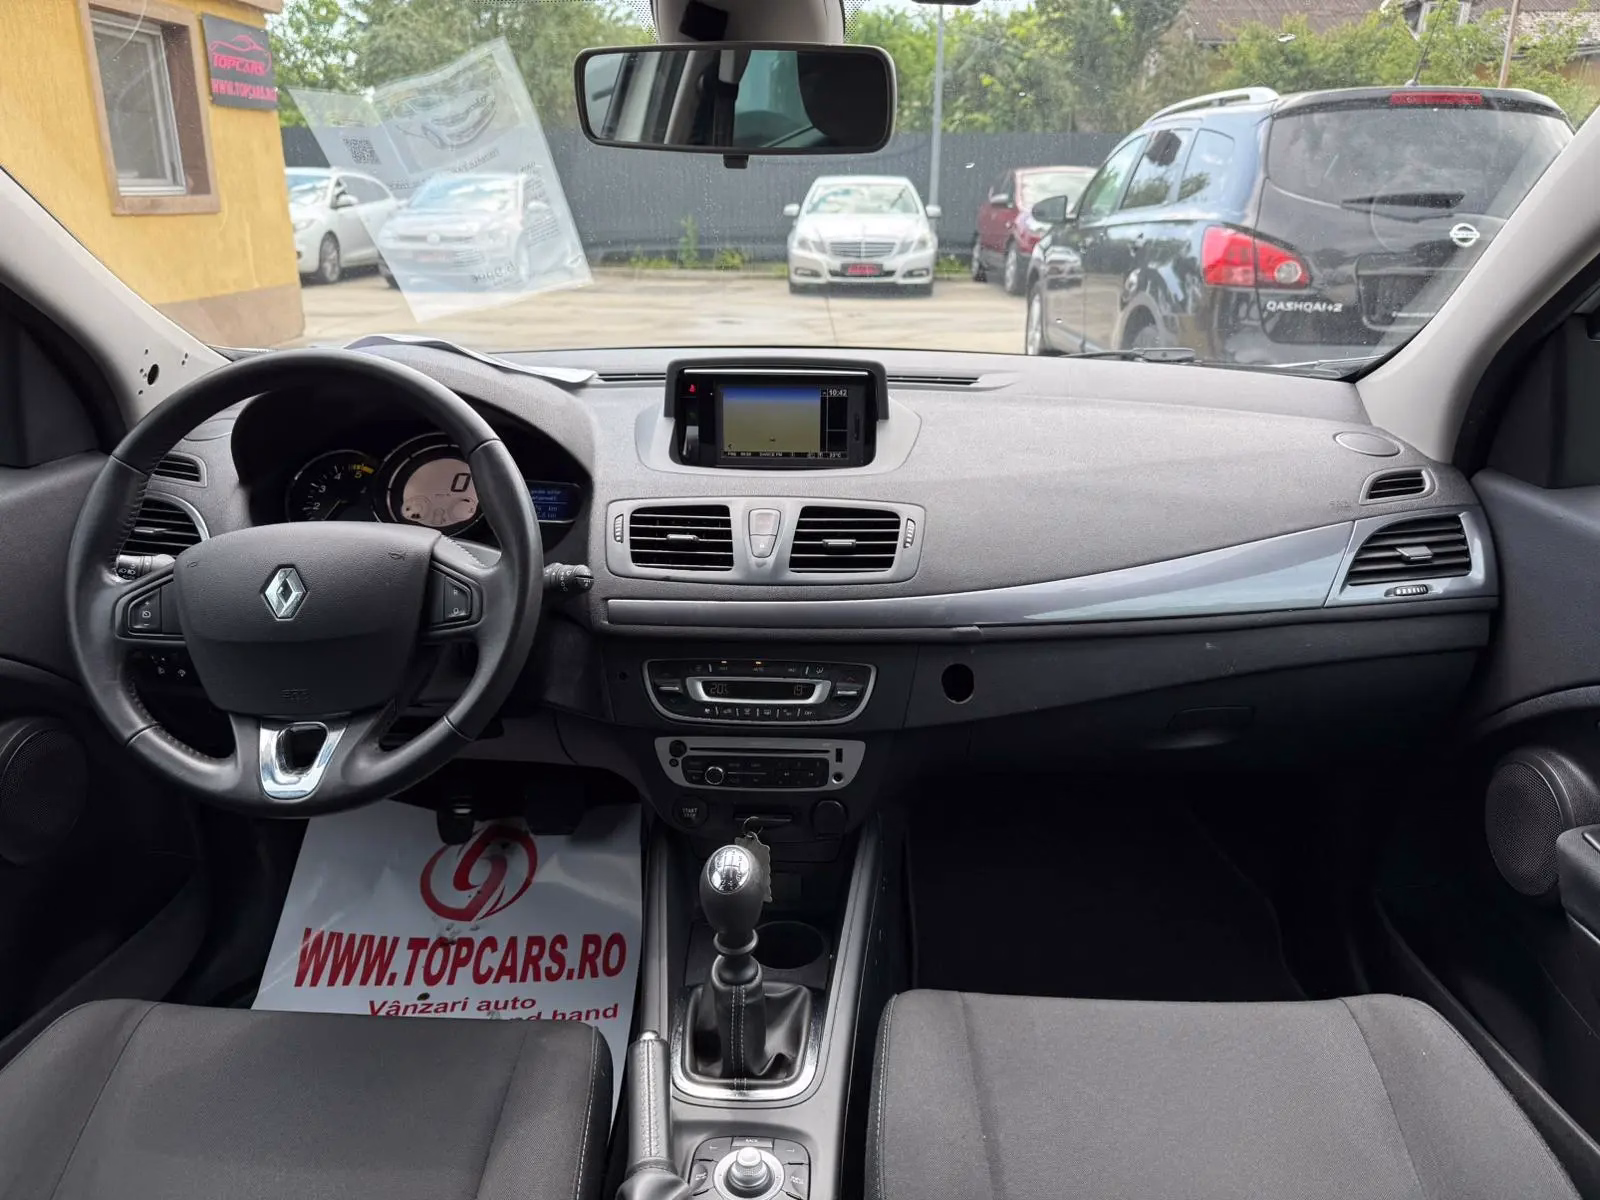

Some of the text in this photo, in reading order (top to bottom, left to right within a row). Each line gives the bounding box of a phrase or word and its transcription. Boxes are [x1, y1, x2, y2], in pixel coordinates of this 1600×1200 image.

[1266, 300, 1343, 313] QASHQAI+2
[319, 485, 326, 493] 3
[451, 473, 471, 492] 0
[313, 502, 321, 510] 2
[294, 928, 627, 987] WWW.TOPCARS.RO
[368, 997, 469, 1017] Vânzari
[476, 996, 536, 1012] auto
